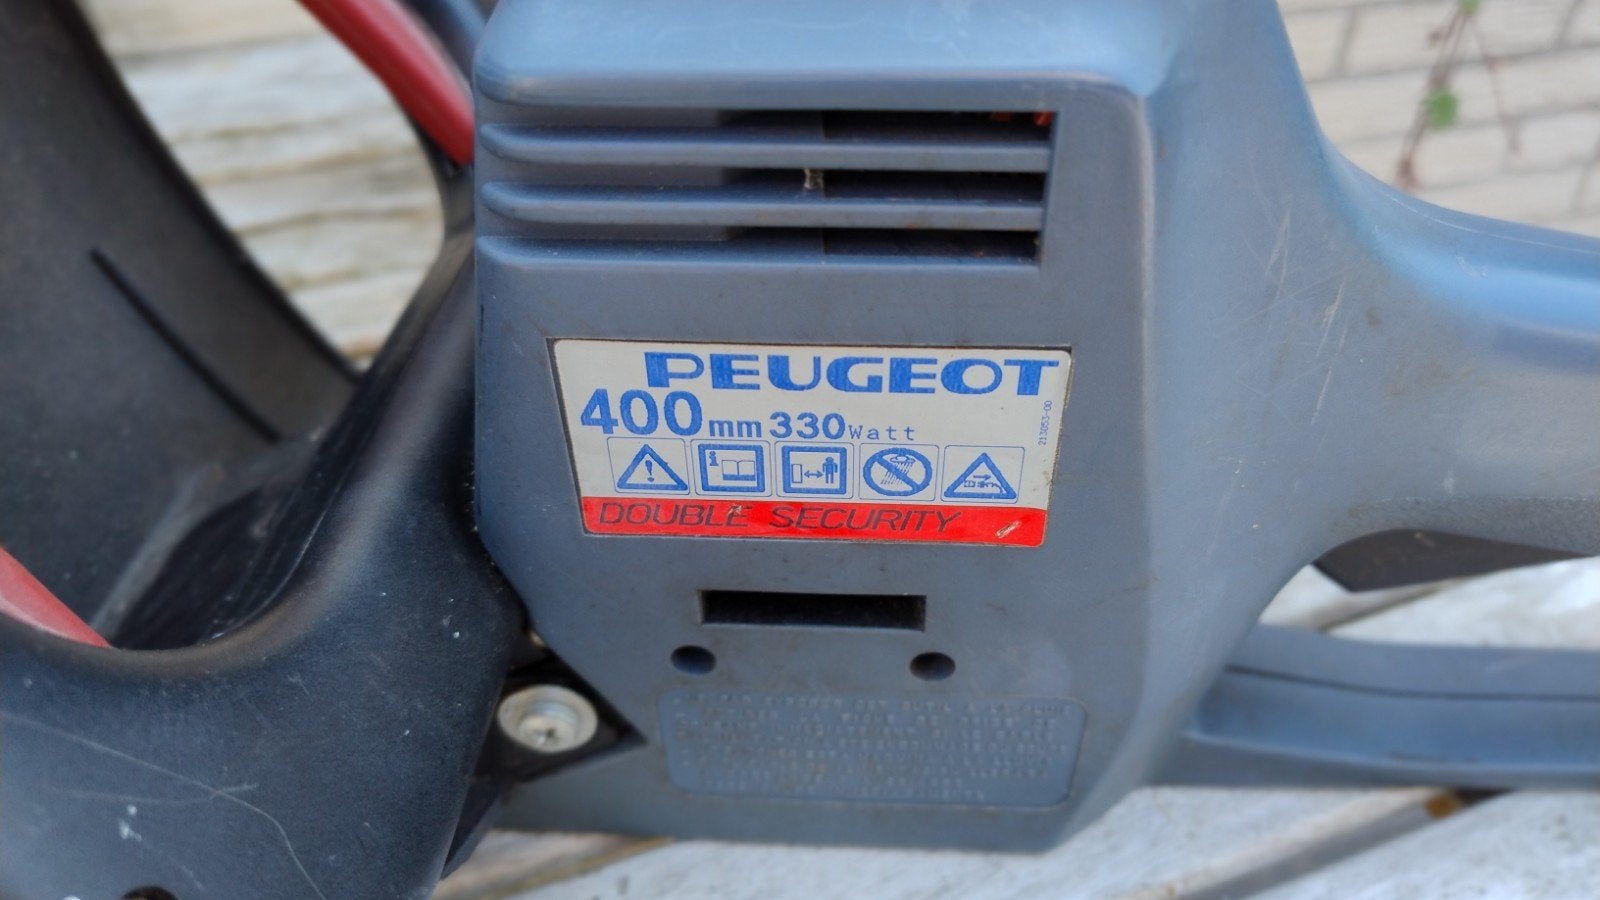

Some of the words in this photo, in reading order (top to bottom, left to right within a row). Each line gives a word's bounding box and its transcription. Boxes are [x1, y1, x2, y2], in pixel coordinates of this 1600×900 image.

[644, 352, 1060, 396] PEUGEOT
[580, 388, 703, 436] 400
[708, 419, 763, 438] mm
[769, 411, 846, 440] 330
[848, 425, 916, 441] Watt
[600, 502, 752, 527] DOUBLE
[768, 505, 962, 532] SECURITY
